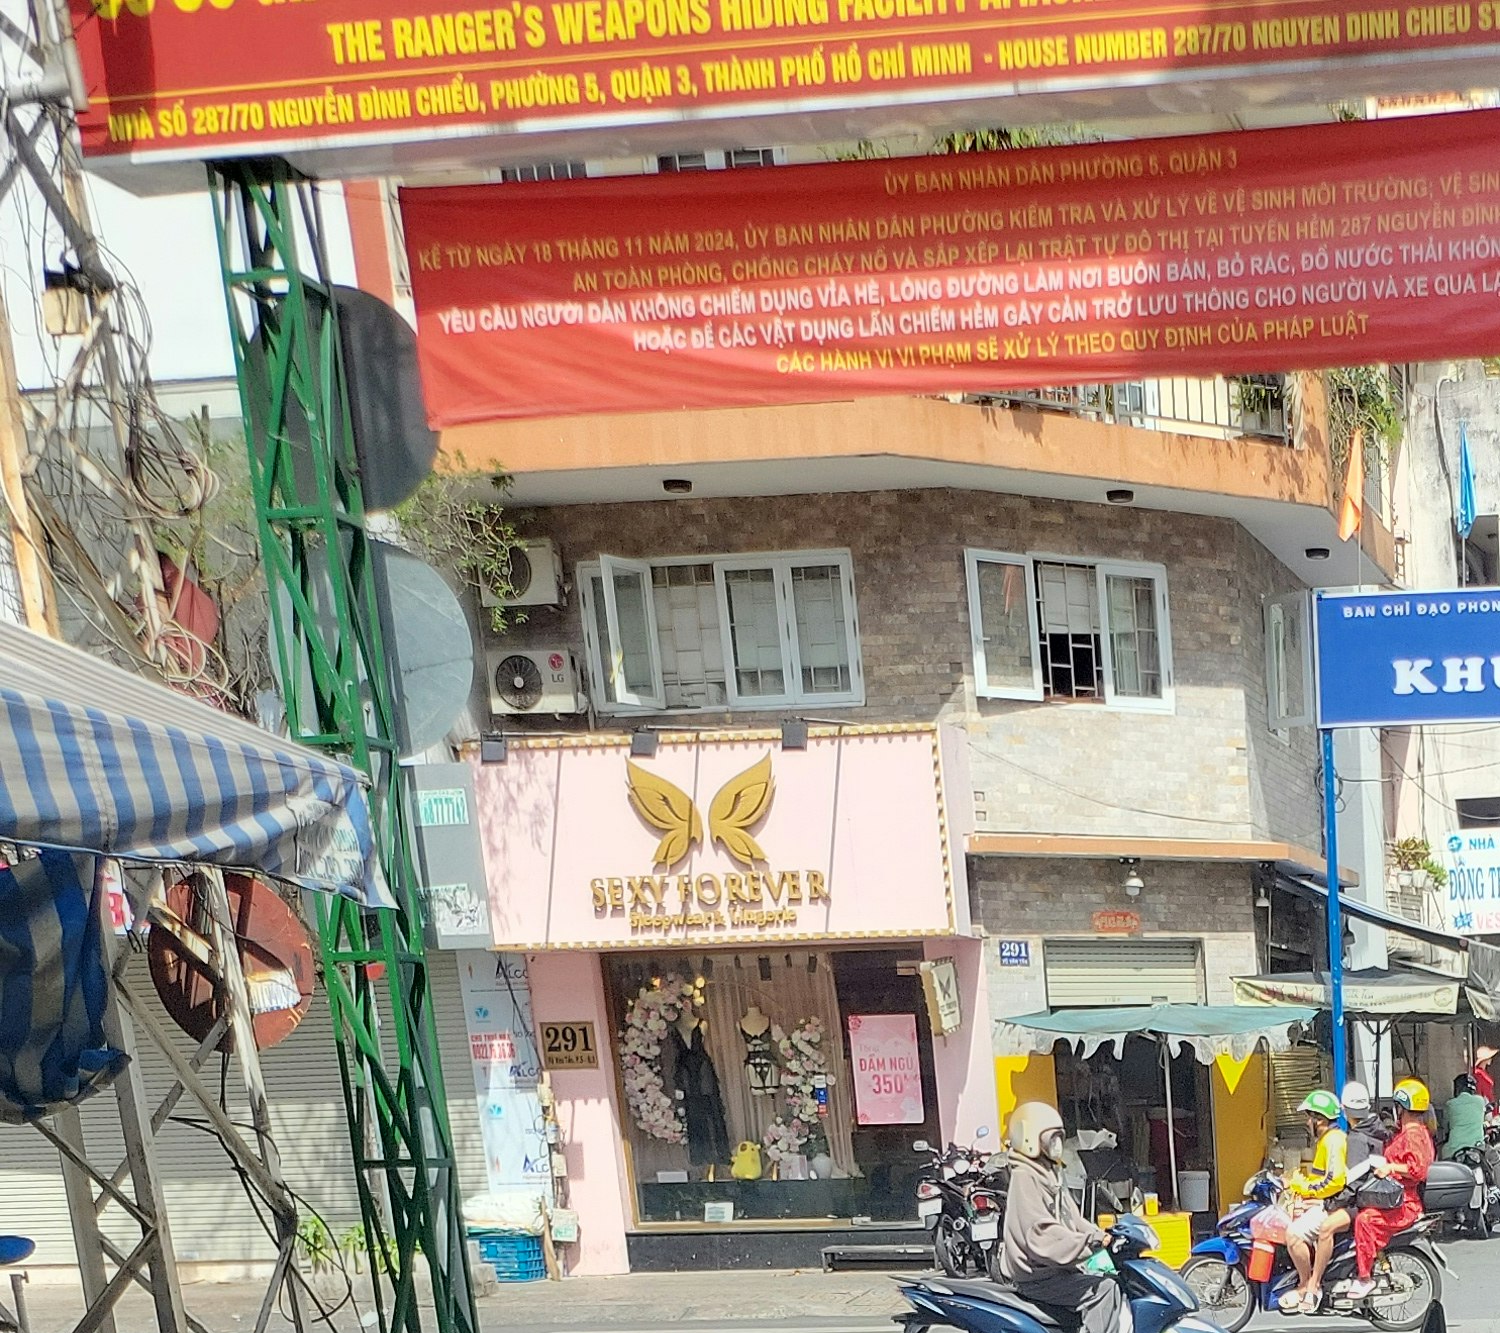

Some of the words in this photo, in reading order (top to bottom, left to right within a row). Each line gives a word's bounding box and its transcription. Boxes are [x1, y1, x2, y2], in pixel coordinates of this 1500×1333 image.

[327, 21, 385, 63] THE
[392, 6, 545, 58] RANGER'S
[553, 0, 710, 44] WEAPONS
[108, 112, 155, 140] NHÀ
[158, 100, 187, 137] SỐ
[192, 103, 264, 134] 287/70
[268, 87, 354, 127] NGUYỄN
[358, 87, 410, 120] ĐÌNH
[416, 75, 485, 115] CHIỂU,
[491, 71, 579, 109] PHƯỜNG
[584, 73, 605, 104] 5,
[611, 64, 671, 102] QUẬN
[677, 66, 697, 96] 3,
[702, 56, 775, 92] THÀNH
[781, 46, 825, 86] PHỐ
[831, 43, 861, 82] HỒ
[868, 43, 905, 79] CHÍ
[911, 43, 971, 75] MINH
[999, 37, 1068, 69] HOUSE
[1075, 28, 1166, 63] NUMBER
[1173, 25, 1245, 55] 287/70
[1253, 16, 1339, 48] NGUYEN
[1347, 10, 1399, 41] DINH
[1406, 4, 1470, 36] CHIEU
[438, 308, 475, 333] YÊU
[479, 306, 517, 330] CẦU
[520, 302, 586, 327] NGƯỜI
[586, 299, 626, 323] DÂN
[630, 293, 695, 327] KHÔNG
[700, 288, 755, 315] CHIẾM
[760, 287, 813, 319] DỤNG
[854, 278, 884, 312] HÈ,
[890, 276, 942, 307] LÒNG
[947, 270, 1018, 304] ĐƯỜNG
[1024, 267, 1063, 292] LÀM
[1069, 266, 1102, 288] NƠI
[1106, 259, 1159, 292] BUÔN
[1167, 258, 1210, 281] BÁN,
[1217, 252, 1244, 277] BỎ
[1251, 251, 1295, 275] RÁC,
[1301, 244, 1328, 271] ĐỔ
[1335, 243, 1393, 268] NƯỚC
[1399, 236, 1442, 263] THẢI
[631, 326, 687, 353] HOẶC
[690, 322, 715, 349] ĐỂ
[719, 322, 756, 348] CÁC
[759, 316, 795, 348] VẬT
[800, 318, 854, 344] DỤNG
[859, 309, 894, 337] LẤN
[900, 305, 955, 333] CHIẾM
[960, 301, 998, 329] HẺM
[1004, 299, 1043, 325] GÂY
[1048, 294, 1086, 322] CẢN
[1092, 290, 1132, 318] TRỞ
[1137, 294, 1176, 316] LƯU
[1183, 287, 1249, 312] THÔNG
[1255, 285, 1296, 307] CHO
[1302, 277, 1366, 304] NGƯỜI
[1372, 275, 1398, 298] VÀ
[1404, 275, 1428, 296] XE
[1435, 273, 1476, 295] QUA
[1343, 606, 1375, 617] BAN
[1417, 602, 1450, 616] ĐẠO
[1469, 834, 1495, 849] NHÀ
[591, 875, 669, 907] SEXY
[677, 869, 830, 904] FOREVER
[1002, 942, 1027, 957] 291
[545, 1026, 592, 1052] 291
